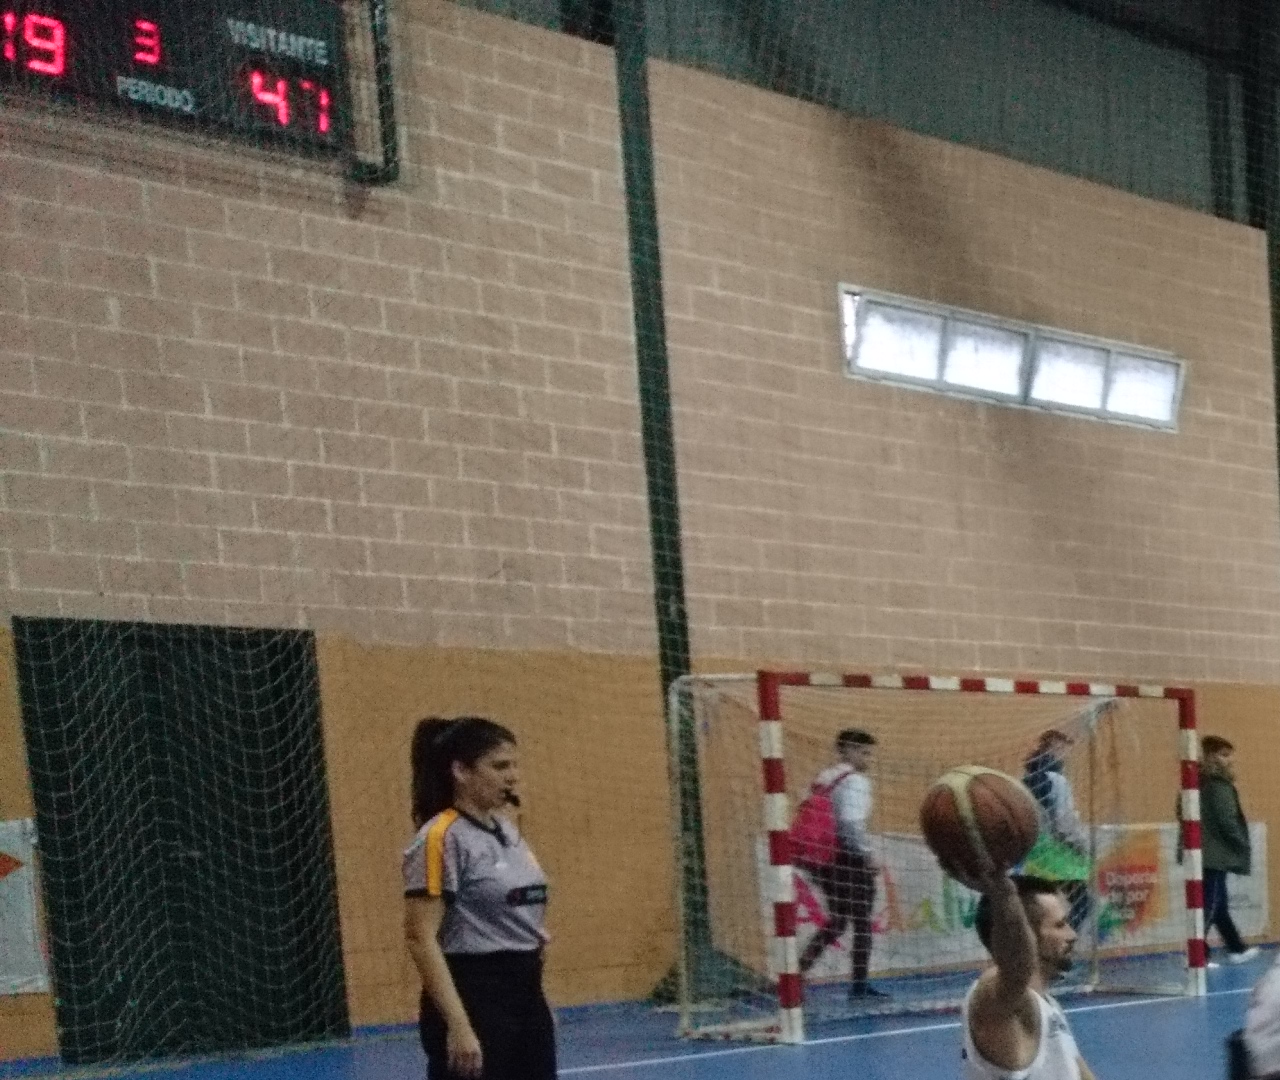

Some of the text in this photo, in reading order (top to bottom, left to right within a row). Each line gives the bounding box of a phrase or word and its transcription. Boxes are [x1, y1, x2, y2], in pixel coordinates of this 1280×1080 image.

[134, 19, 160, 63] 3
[116, 75, 197, 115] PERIODO
[249, 68, 332, 133] 47
